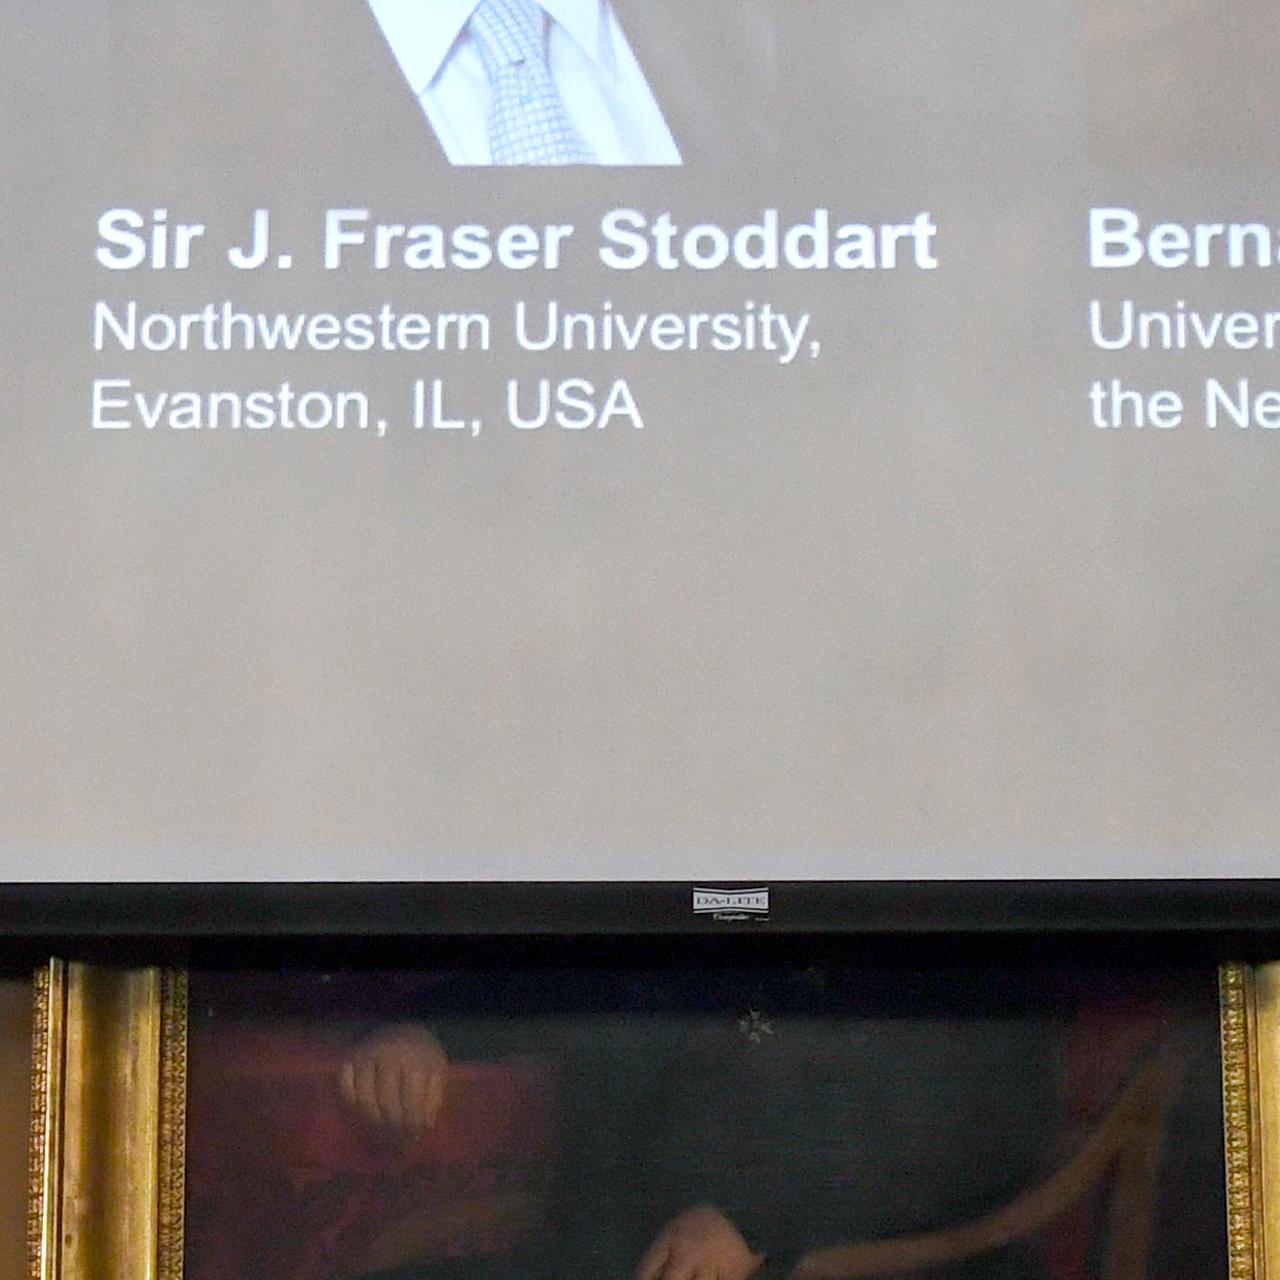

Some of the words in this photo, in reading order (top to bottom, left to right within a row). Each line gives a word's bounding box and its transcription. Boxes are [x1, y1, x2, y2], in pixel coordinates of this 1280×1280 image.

[96, 208, 205, 270] Sir
[227, 209, 293, 269] J.
[324, 209, 574, 270] Fraser
[599, 208, 939, 270] Stoddart
[93, 301, 490, 351] Northwestern
[515, 300, 821, 364] University,
[91, 379, 387, 437] Evanston,
[414, 379, 481, 437] IL,
[507, 378, 644, 429] USA
[1089, 379, 1184, 429] the
